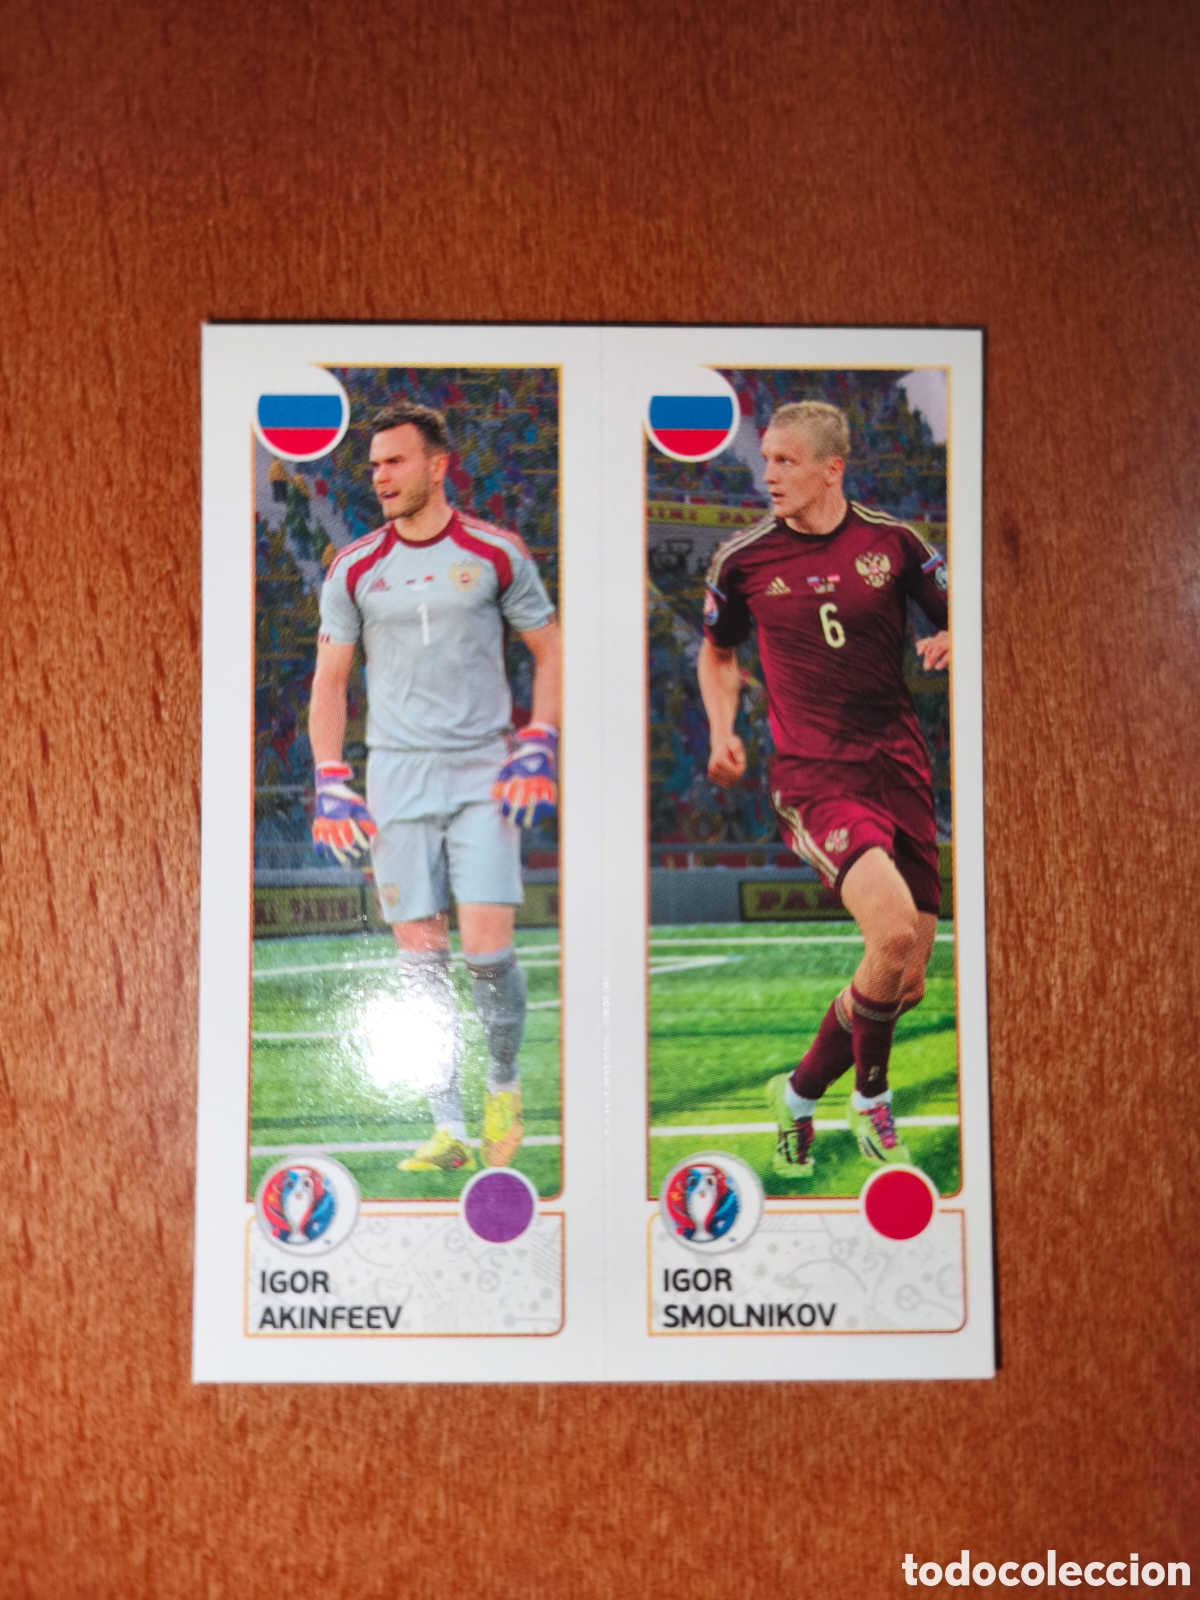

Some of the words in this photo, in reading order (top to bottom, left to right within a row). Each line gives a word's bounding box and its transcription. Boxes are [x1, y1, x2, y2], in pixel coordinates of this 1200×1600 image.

[417, 603, 430, 646] 1
[819, 602, 846, 648] 6
[290, 896, 357, 922] PANINI
[260, 1269, 330, 1294] IGOR
[663, 1267, 733, 1292] IGOR
[258, 1304, 403, 1330] AKINFEEV
[662, 1302, 837, 1328] SMOLNIKOV
